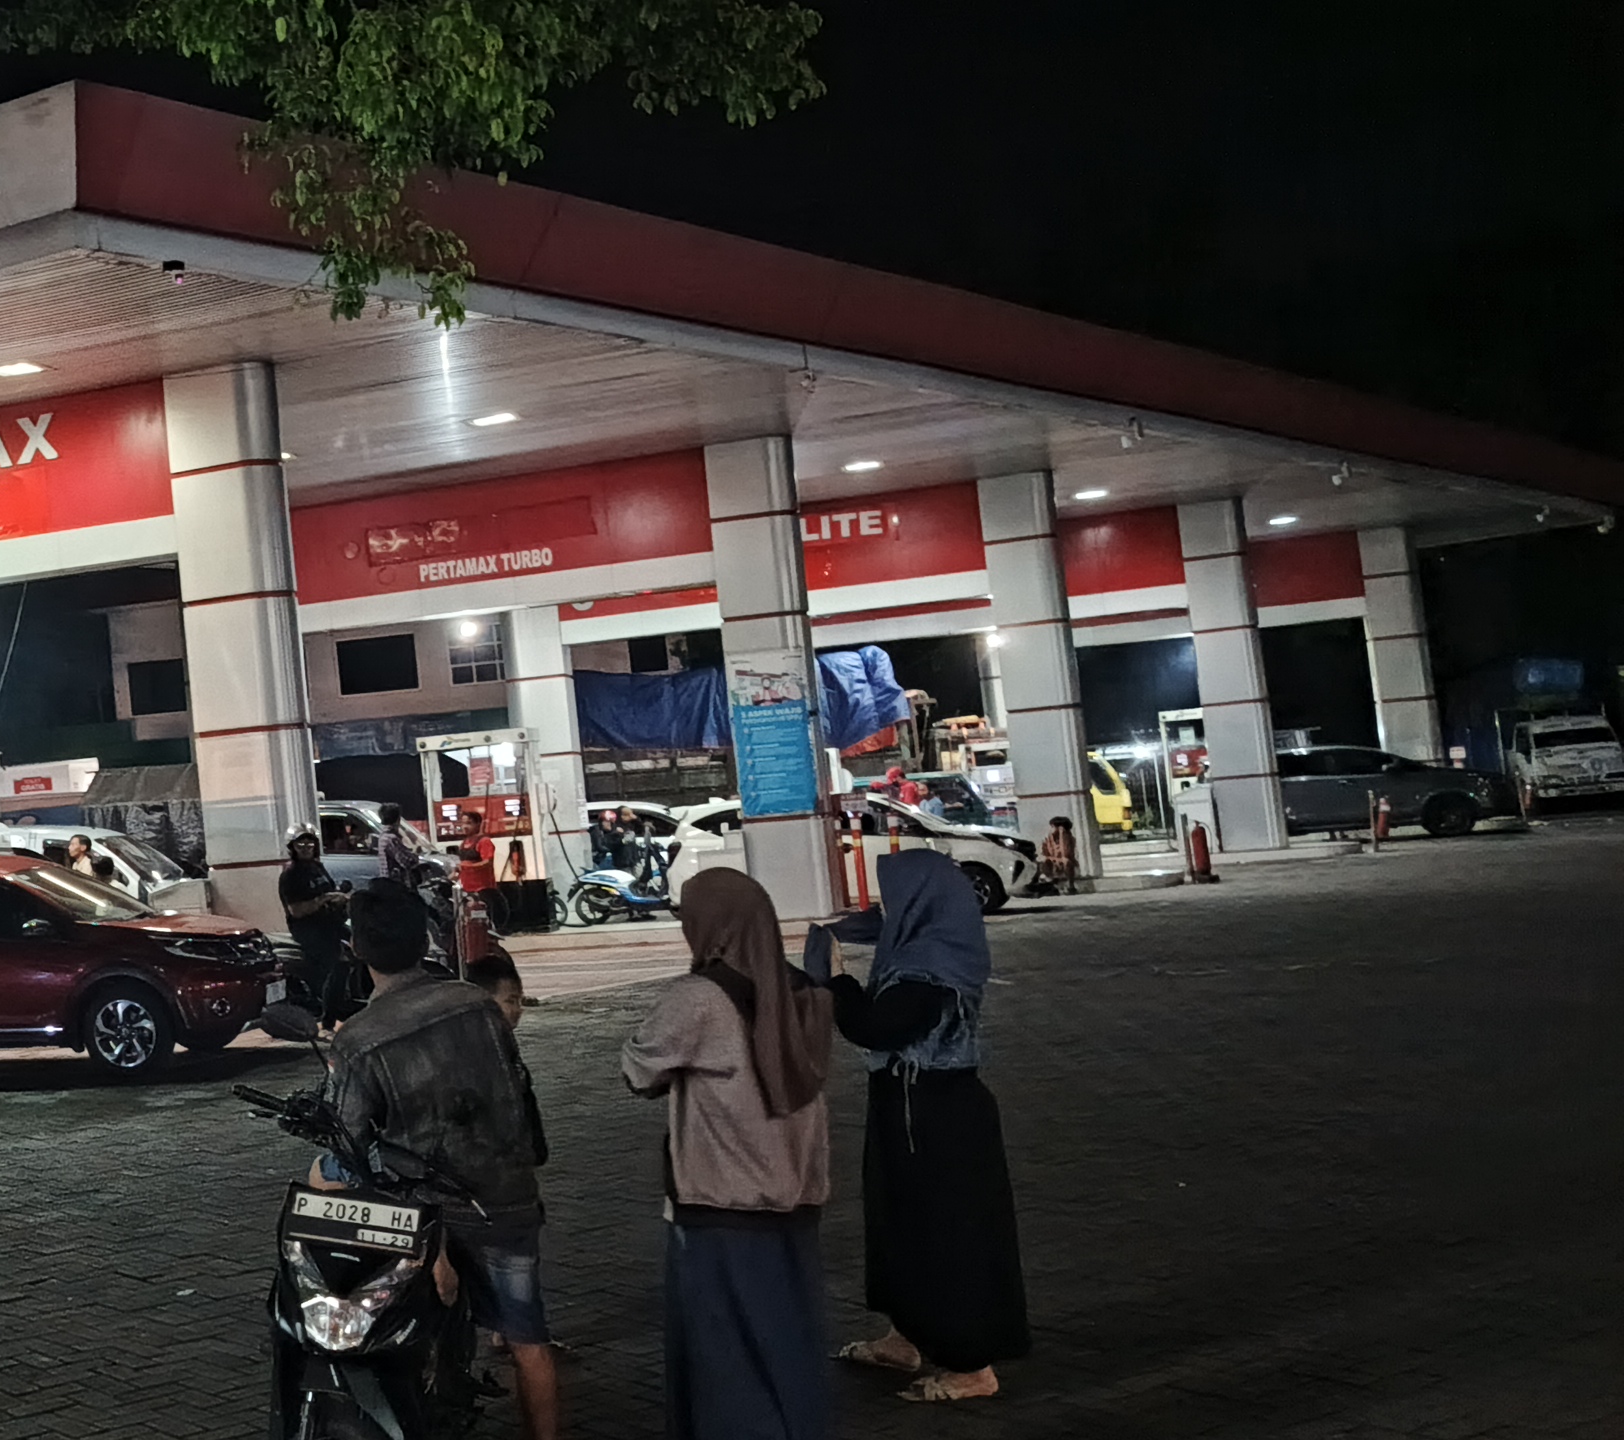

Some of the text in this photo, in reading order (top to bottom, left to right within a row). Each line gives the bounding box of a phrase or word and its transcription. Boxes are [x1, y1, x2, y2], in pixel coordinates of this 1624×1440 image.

[419, 547, 554, 583] PERTAMAX TURBO
[296, 1197, 414, 1231] P 2028 HA
